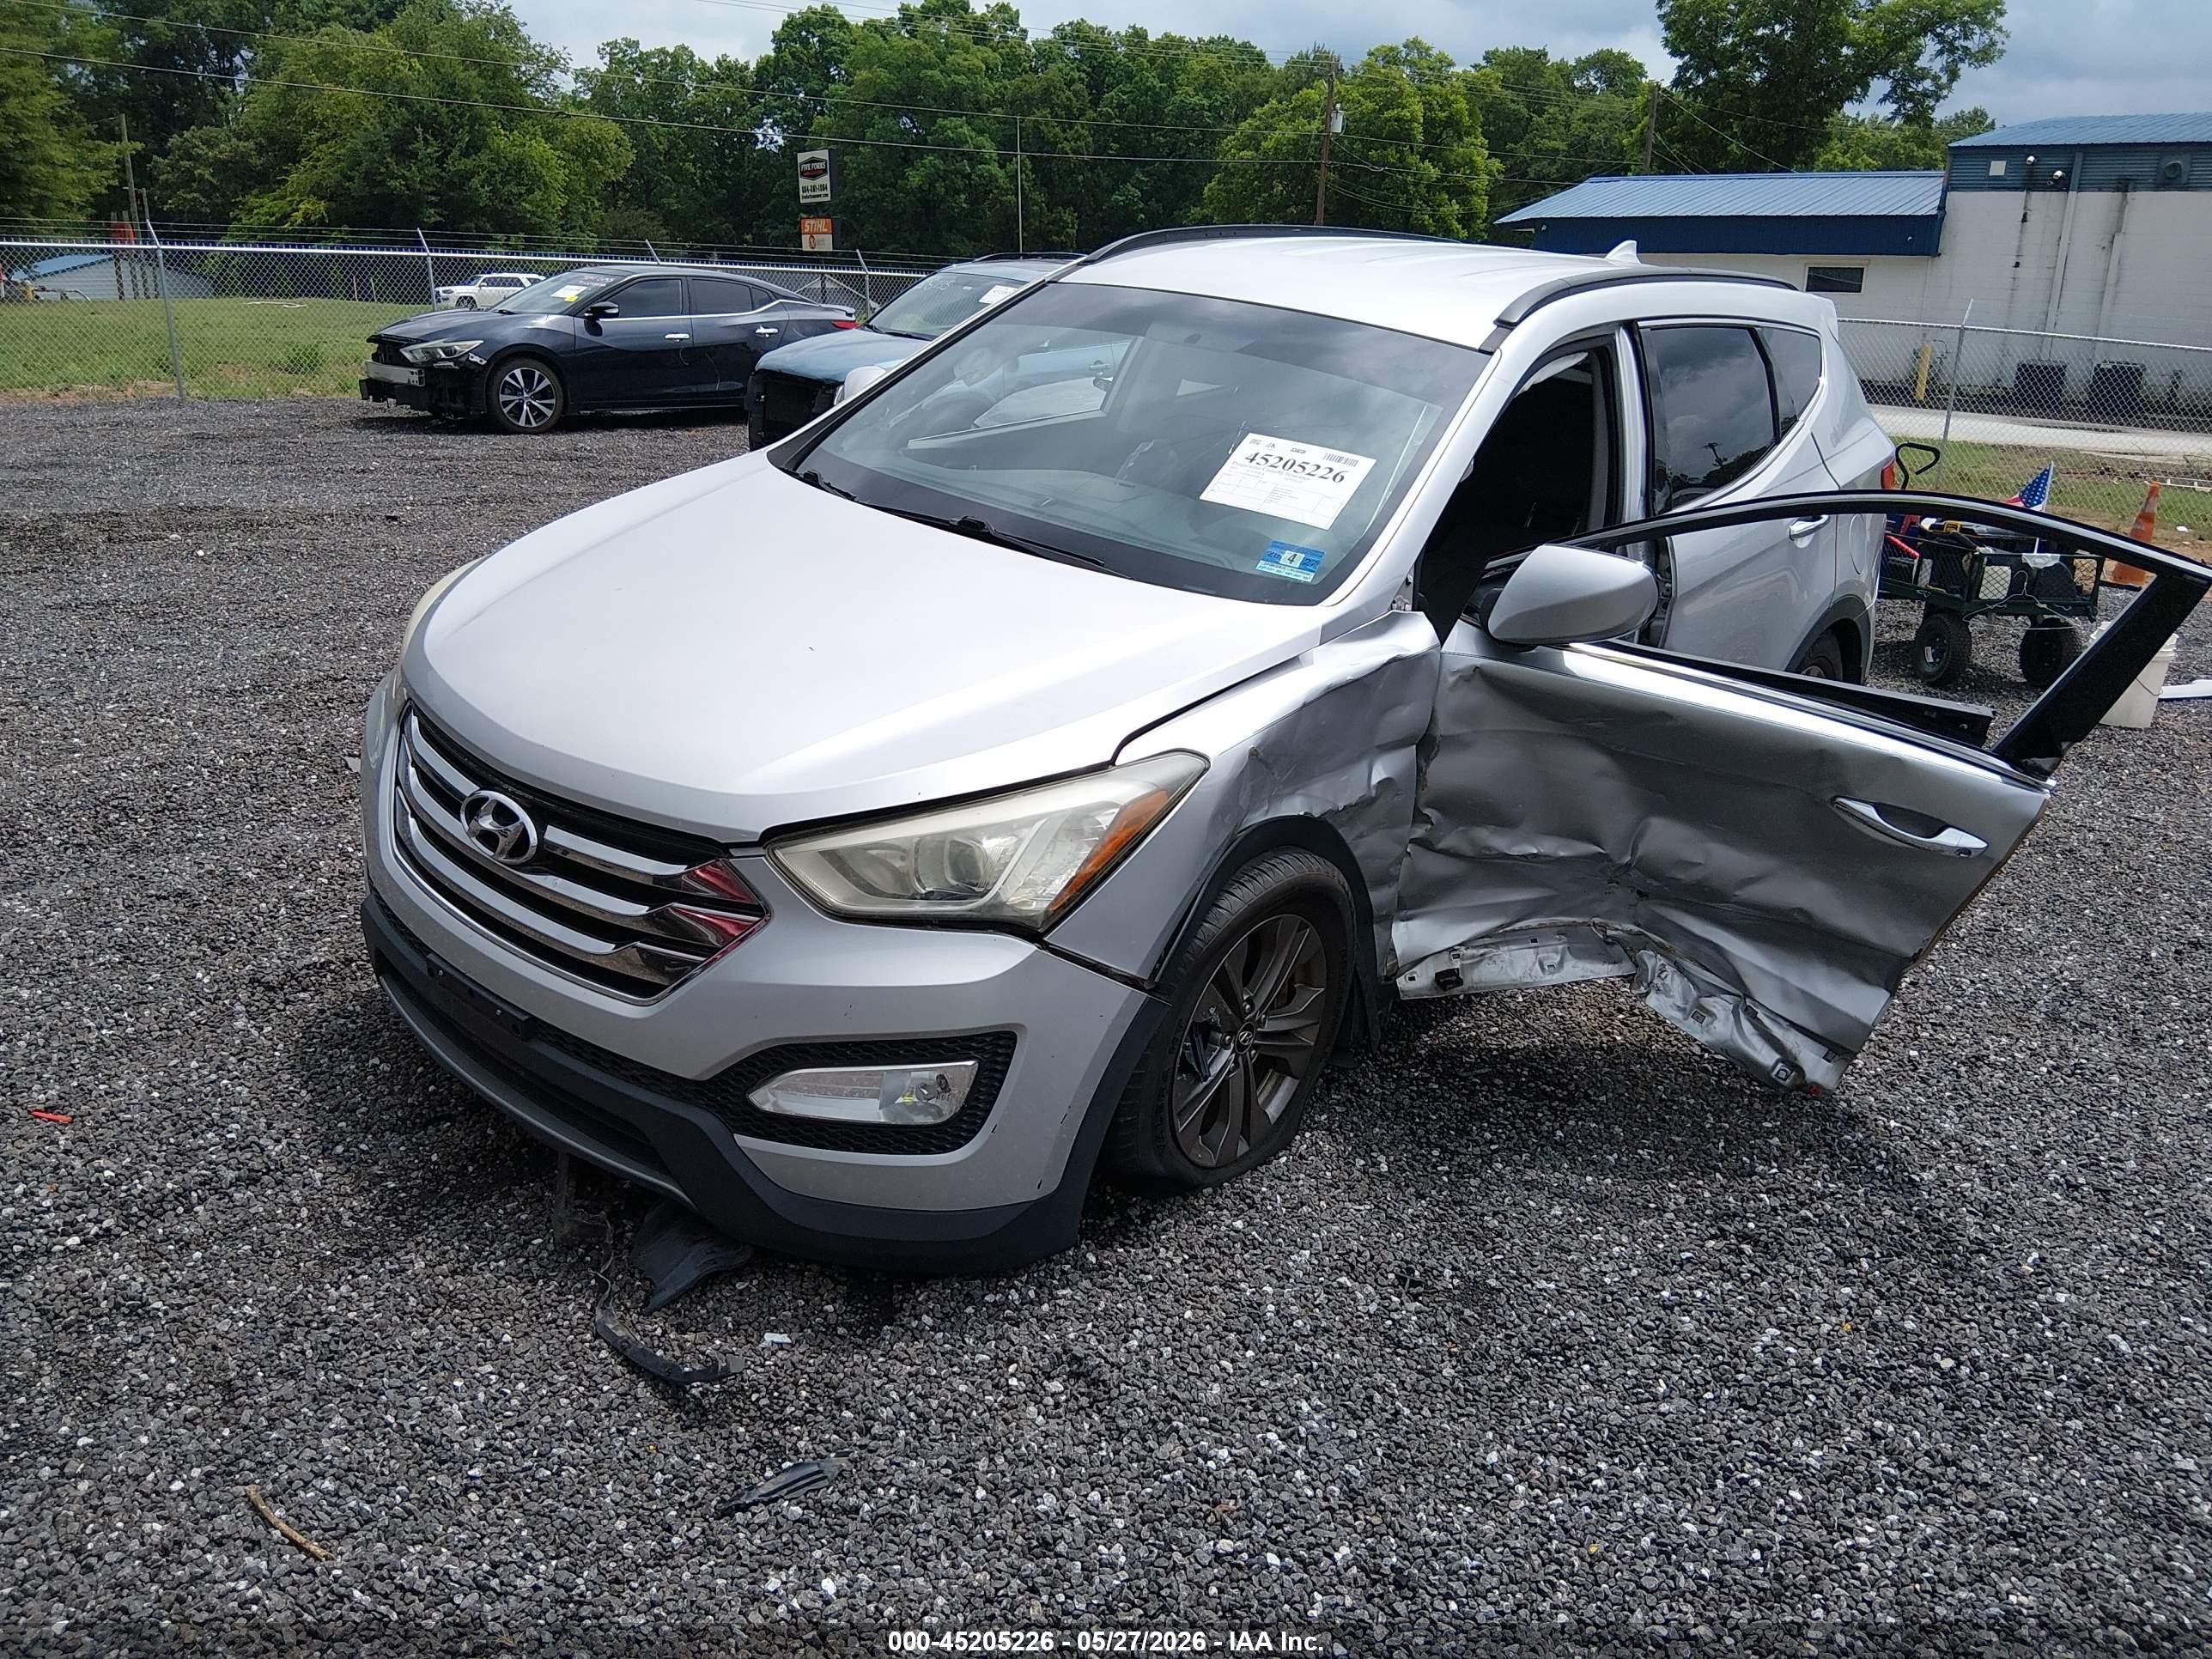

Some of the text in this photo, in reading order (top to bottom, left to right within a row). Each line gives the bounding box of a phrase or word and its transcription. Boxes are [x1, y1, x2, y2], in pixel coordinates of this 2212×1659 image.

[805, 220, 828, 232] STIHL
[1245, 453, 1349, 483] 45205226
[1287, 553, 1297, 564] 4
